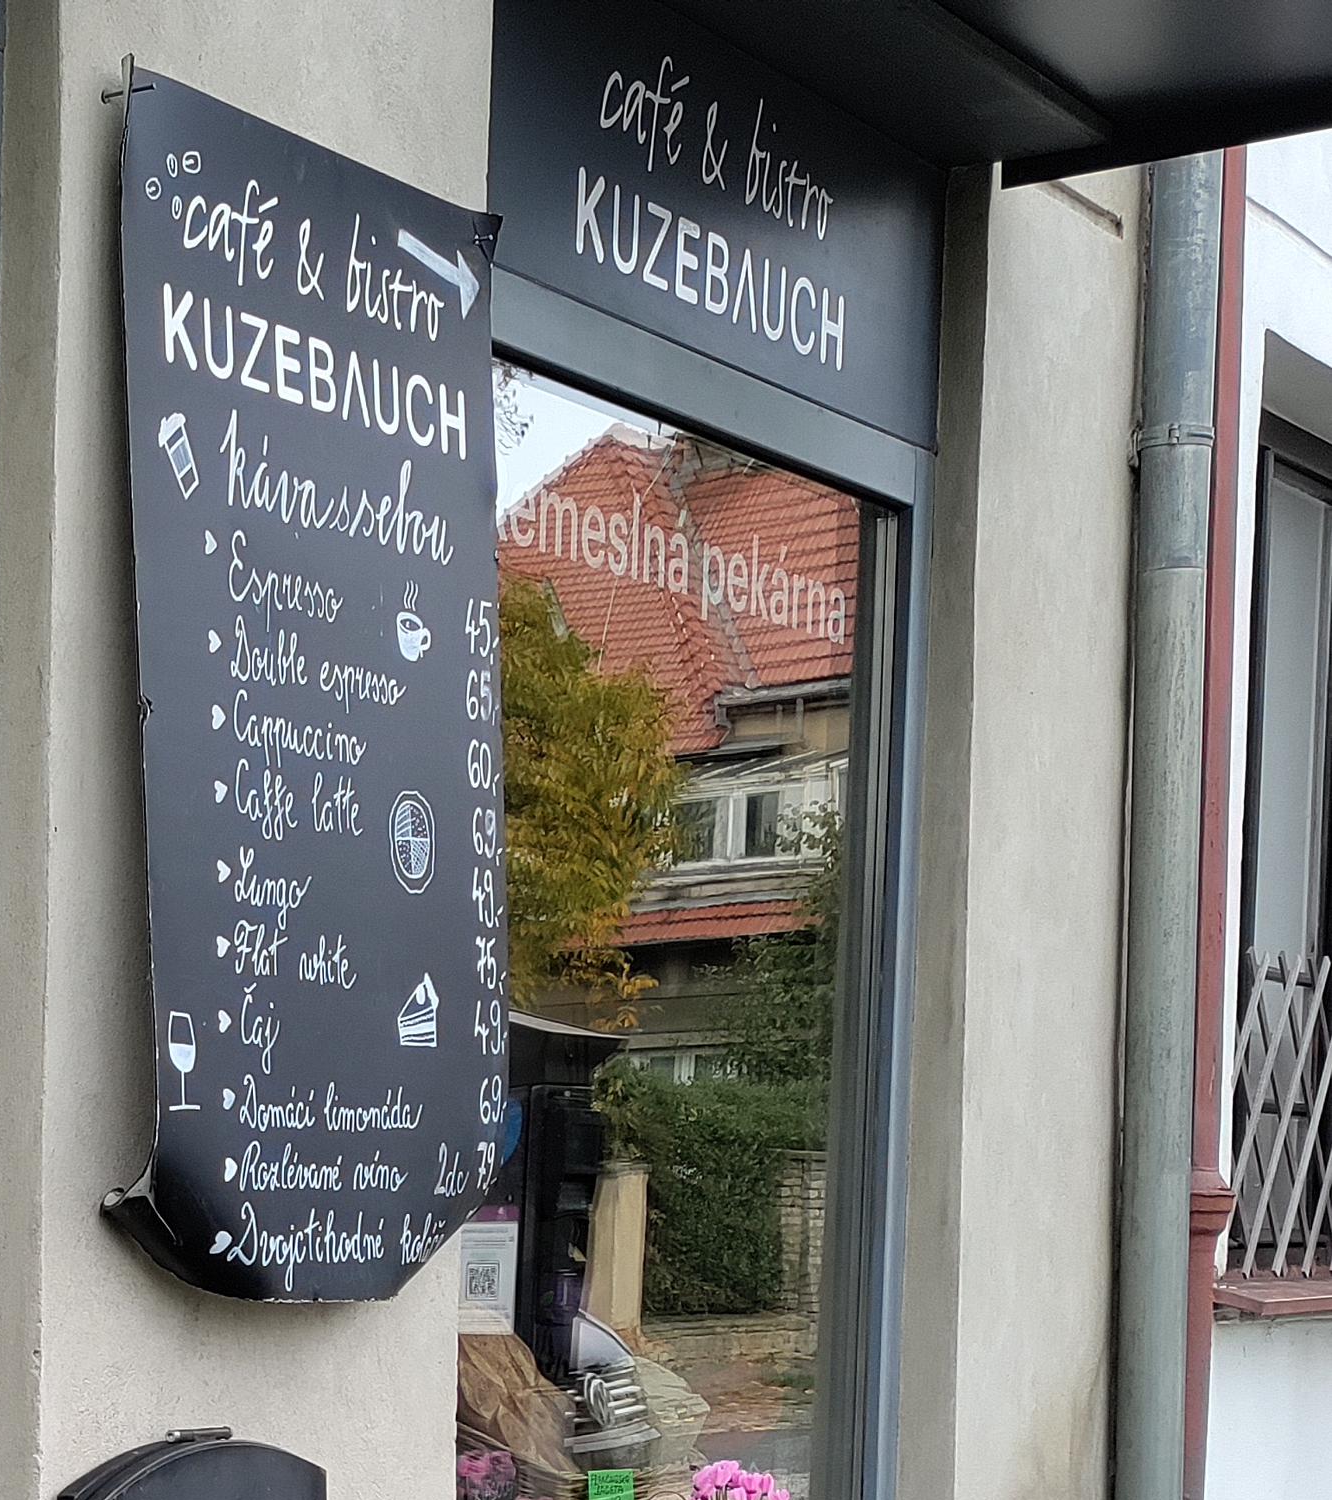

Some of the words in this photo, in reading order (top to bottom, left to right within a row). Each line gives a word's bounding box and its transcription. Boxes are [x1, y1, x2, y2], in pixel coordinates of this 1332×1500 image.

[598, 55, 689, 172] café
[700, 100, 729, 191] &
[744, 97, 834, 241] bistro
[182, 179, 279, 287] café
[296, 218, 325, 300] &
[346, 213, 445, 343] bistro
[574, 166, 845, 371] KUZEBAUCH
[163, 283, 467, 460] KUZEBAUCH
[228, 529, 344, 633] Espresso
[701, 535, 846, 645] pekárna
[230, 614, 308, 686] Double
[319, 660, 407, 714] espresso
[233, 688, 368, 767] Cappuccino
[311, 771, 364, 837] latte
[234, 845, 313, 931] Lungo
[234, 919, 289, 977] Flat
[299, 934, 359, 990] white
[241, 982, 281, 1074] Čaj
[239, 1073, 317, 1130] Domácí
[323, 1081, 425, 1133] limonáda
[240, 1140, 343, 1192] Rozlévané
[353, 1150, 409, 1192] víno
